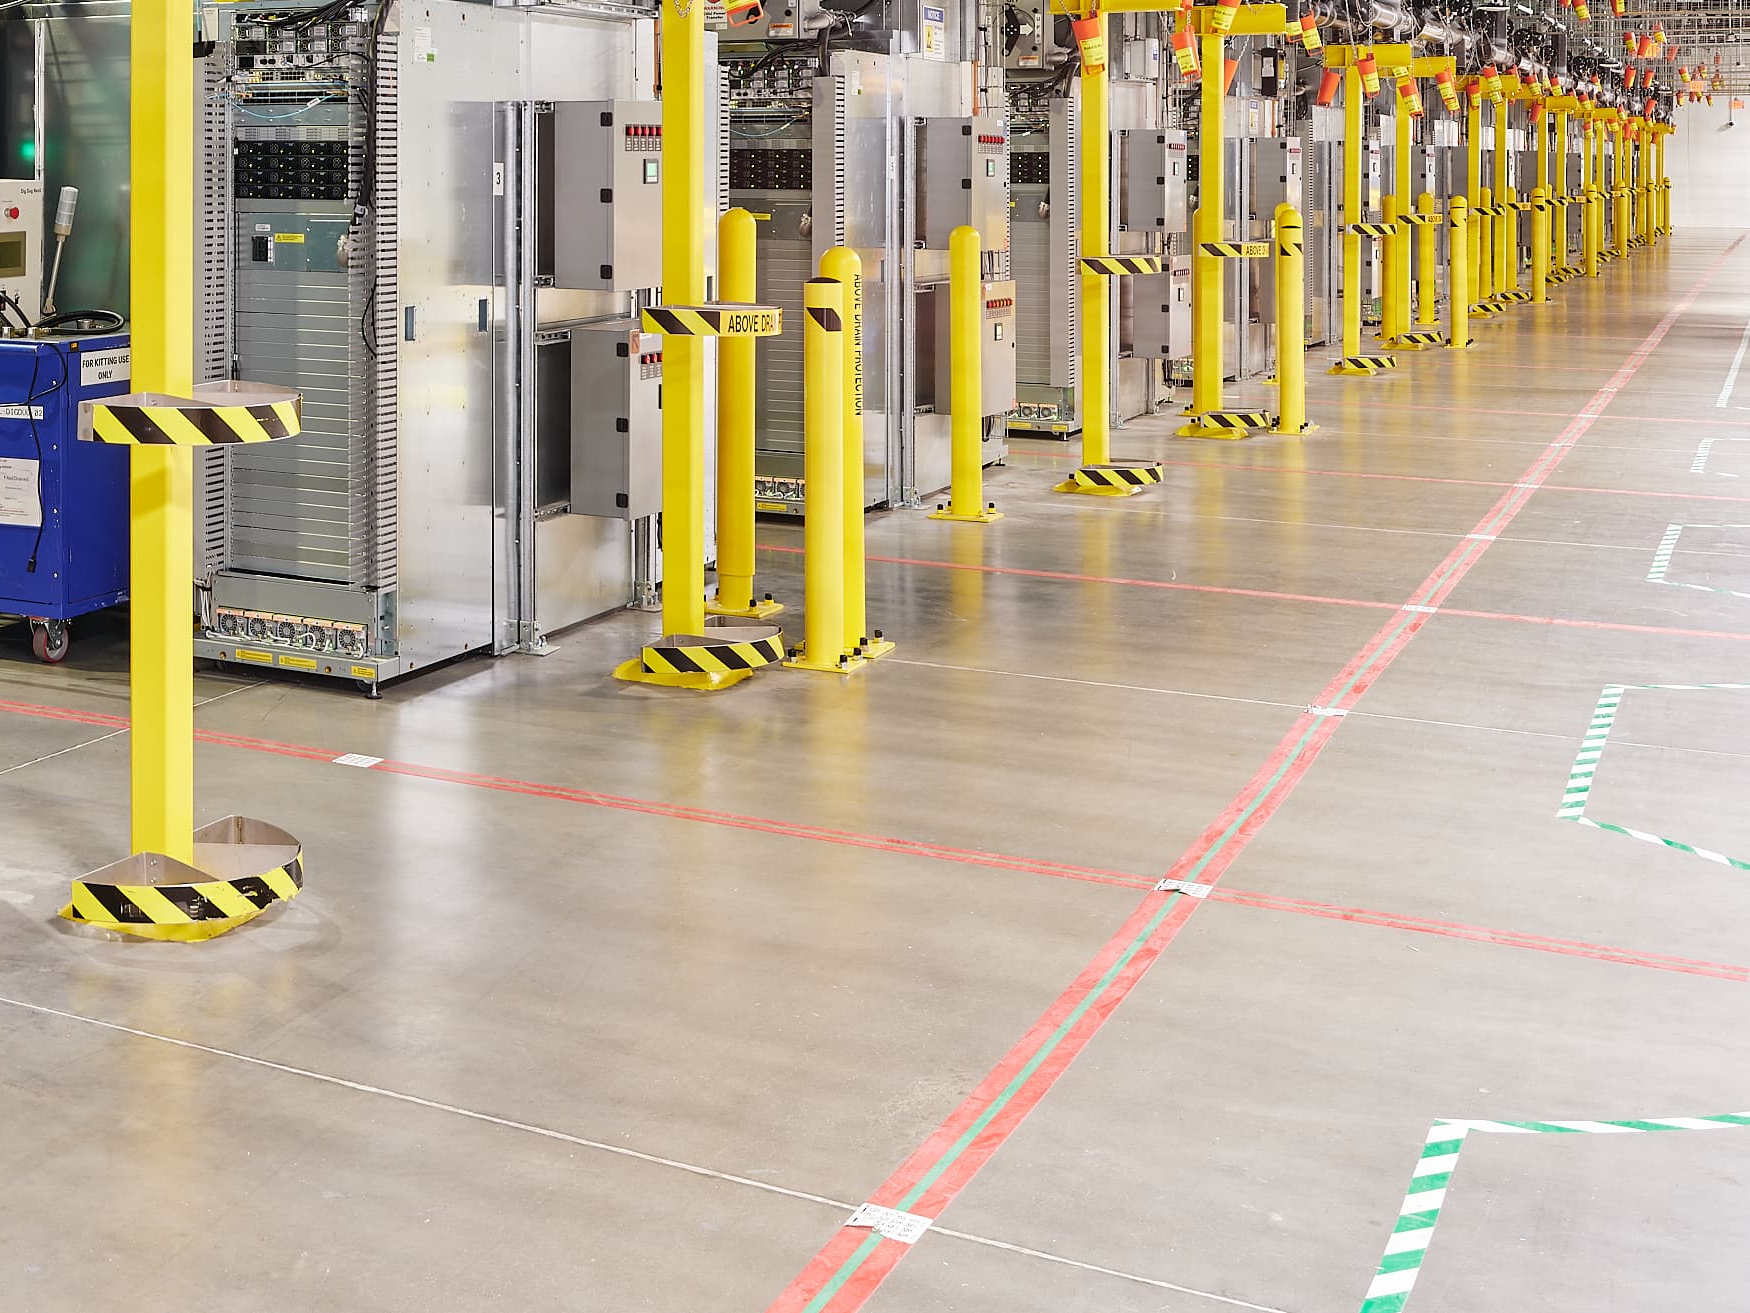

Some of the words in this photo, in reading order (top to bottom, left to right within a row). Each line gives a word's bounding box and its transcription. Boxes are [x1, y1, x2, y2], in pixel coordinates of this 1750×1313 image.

[496, 171, 501, 185] 3
[728, 314, 759, 333] ABOVE
[82, 359, 94, 369] FOR
[94, 356, 117, 368] KITTING
[118, 354, 130, 365] USE
[98, 370, 113, 380] ONLY
